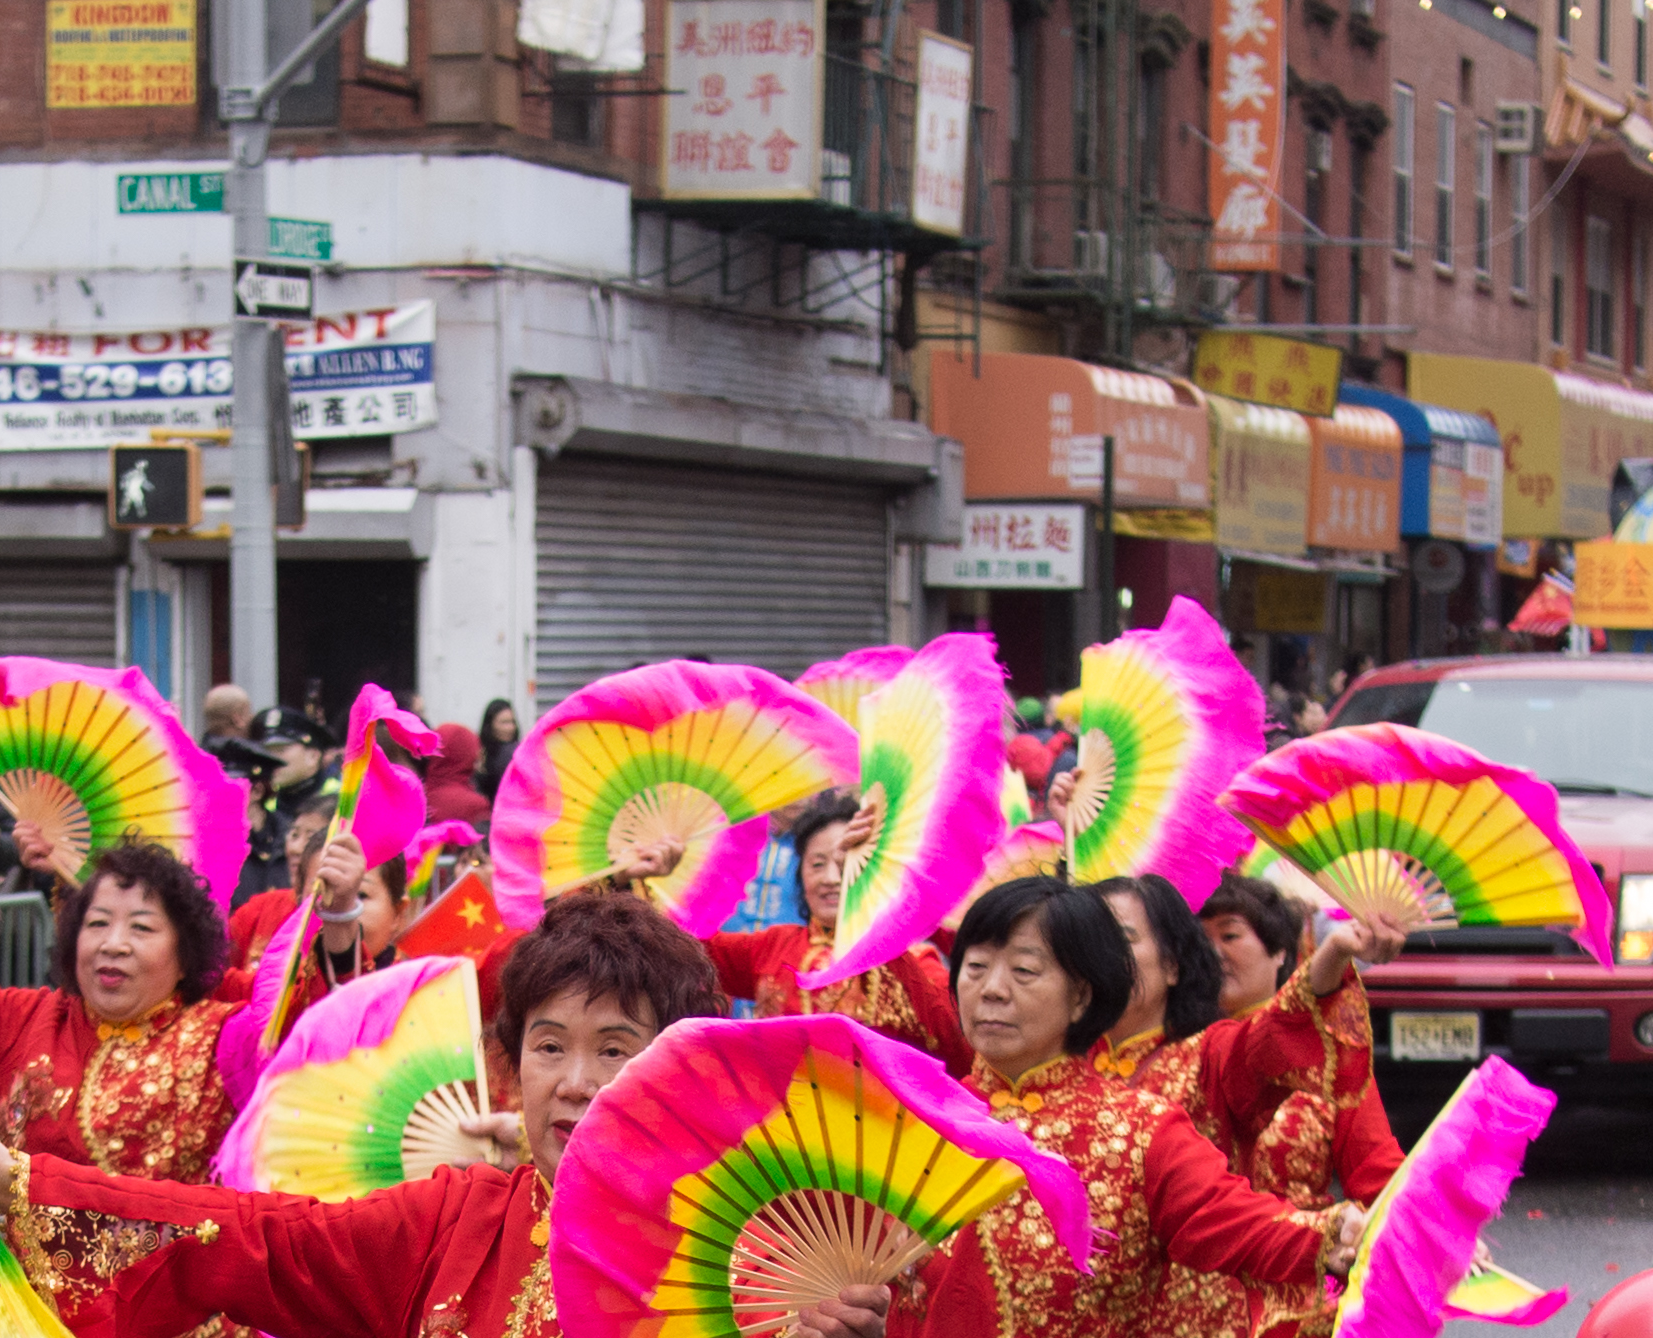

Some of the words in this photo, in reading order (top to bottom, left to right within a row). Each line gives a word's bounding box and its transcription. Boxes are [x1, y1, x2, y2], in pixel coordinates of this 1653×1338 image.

[120, 175, 197, 211] CANAL
[91, 326, 213, 355] FOR
[276, 307, 395, 346] ENT
